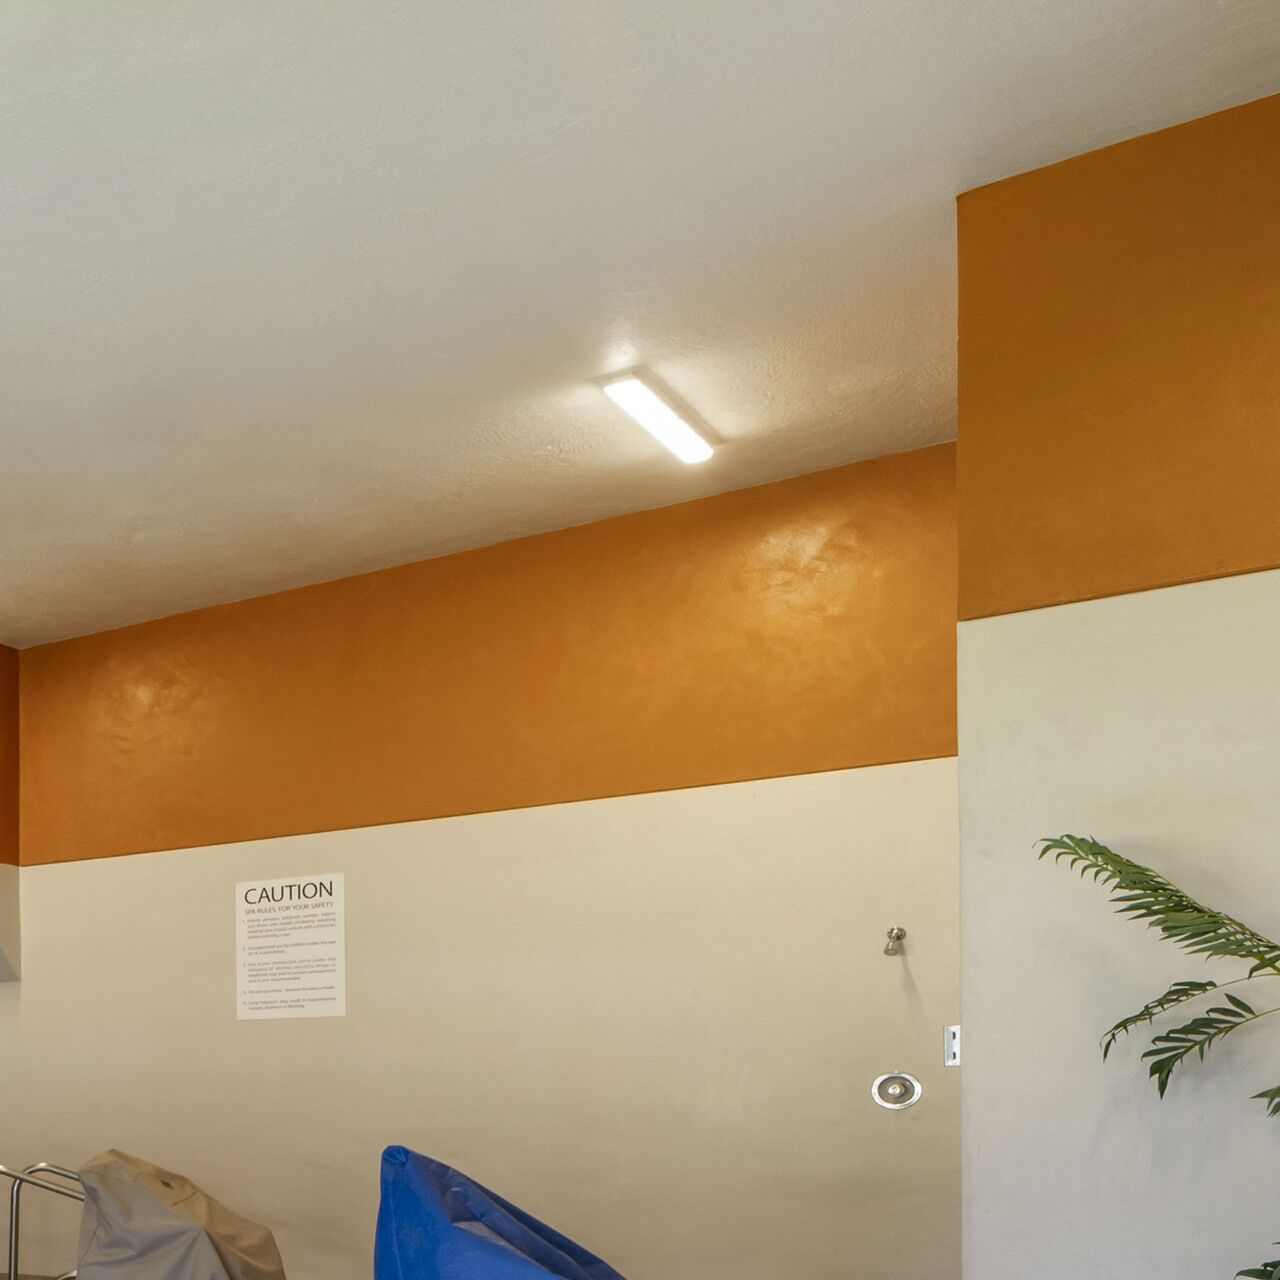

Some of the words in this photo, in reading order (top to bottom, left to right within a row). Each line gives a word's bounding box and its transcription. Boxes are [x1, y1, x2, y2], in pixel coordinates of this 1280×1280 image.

[245, 881, 332, 904] CAUTION
[292, 903, 309, 911] YOUR
[311, 901, 334, 909] SAFETY
